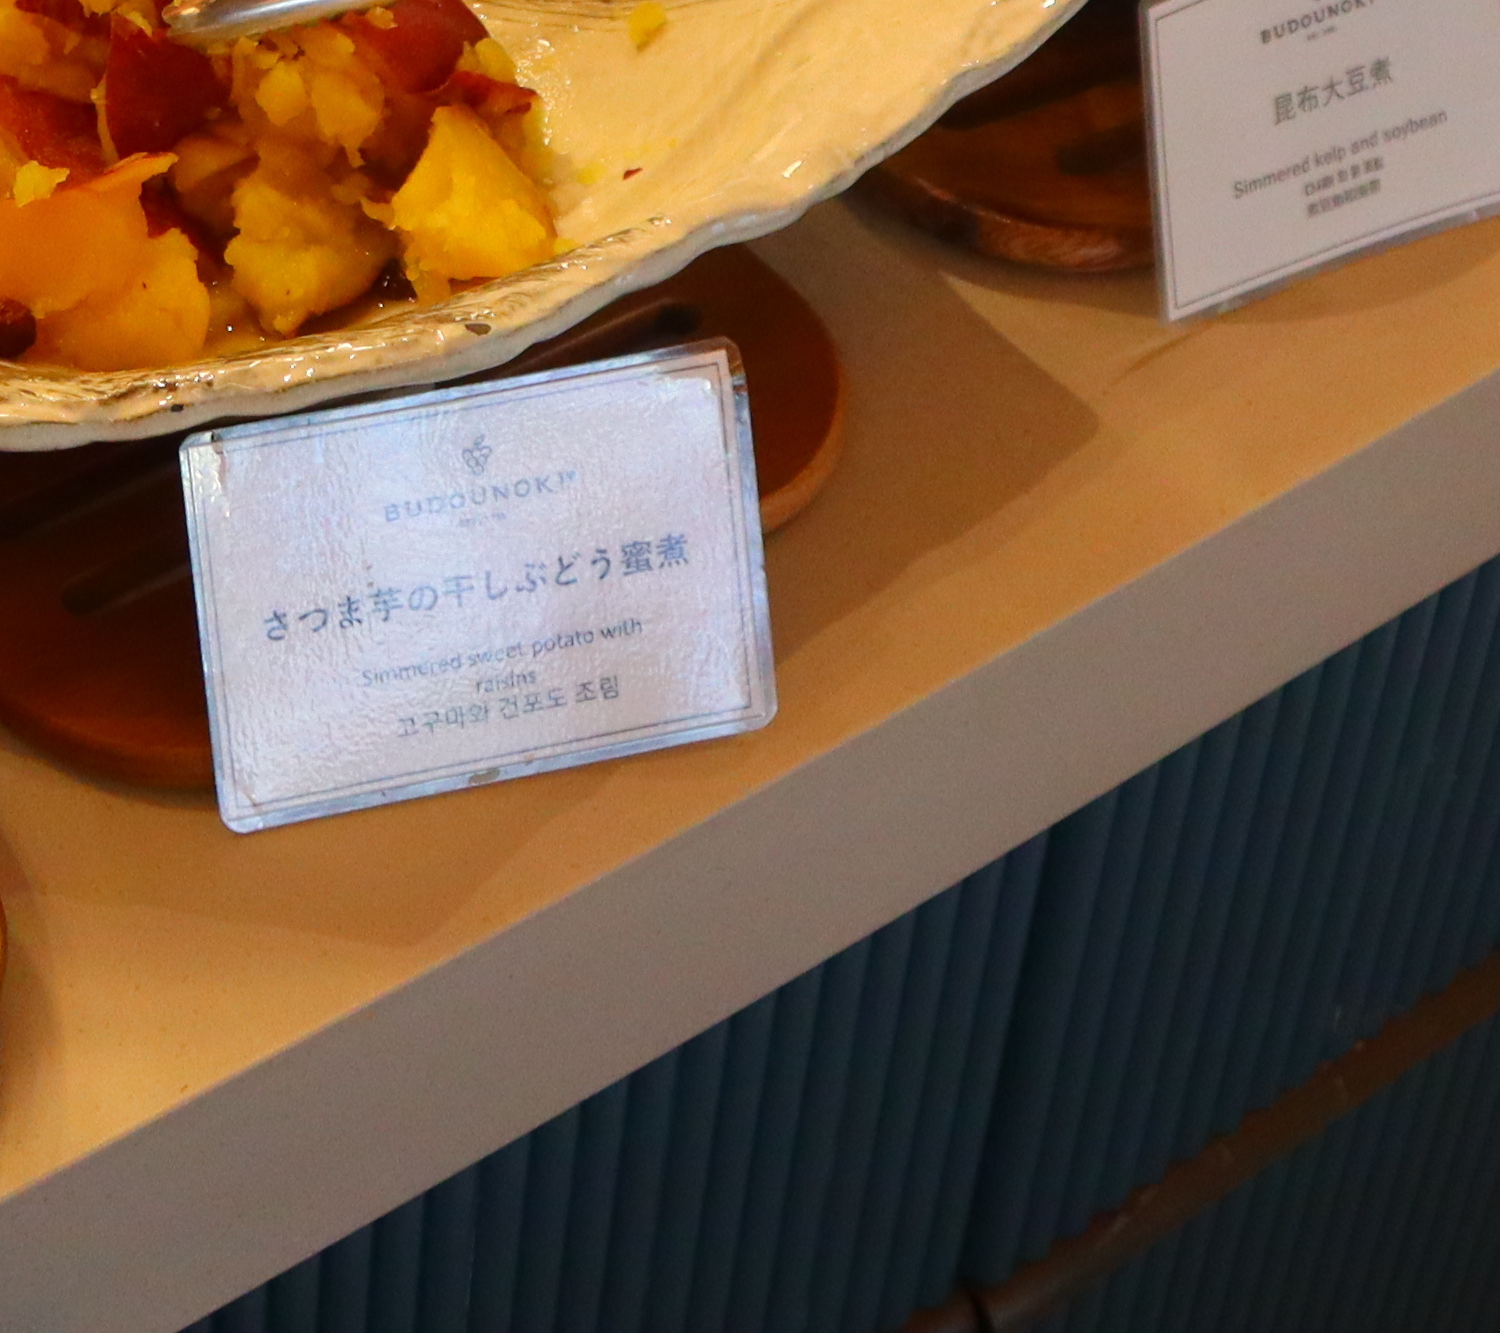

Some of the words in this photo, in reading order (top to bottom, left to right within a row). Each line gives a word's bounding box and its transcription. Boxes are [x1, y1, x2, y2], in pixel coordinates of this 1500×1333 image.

[1273, 56, 1392, 126] 昆布大豆煮
[1232, 155, 1311, 200] Simmered
[1314, 145, 1347, 169] kelp
[1350, 130, 1380, 156] and
[1382, 109, 1449, 144] soybean
[264, 533, 690, 643] さつま芋の干しぶどう蜜煮
[361, 652, 462, 688] Simmered
[467, 641, 526, 670] sweet
[530, 628, 594, 662] potato
[600, 617, 644, 644] with
[475, 668, 538, 695] raisins
[397, 702, 491, 738] 고구마와
[499, 686, 569, 721] 건포도
[575, 674, 621, 704] 조림
